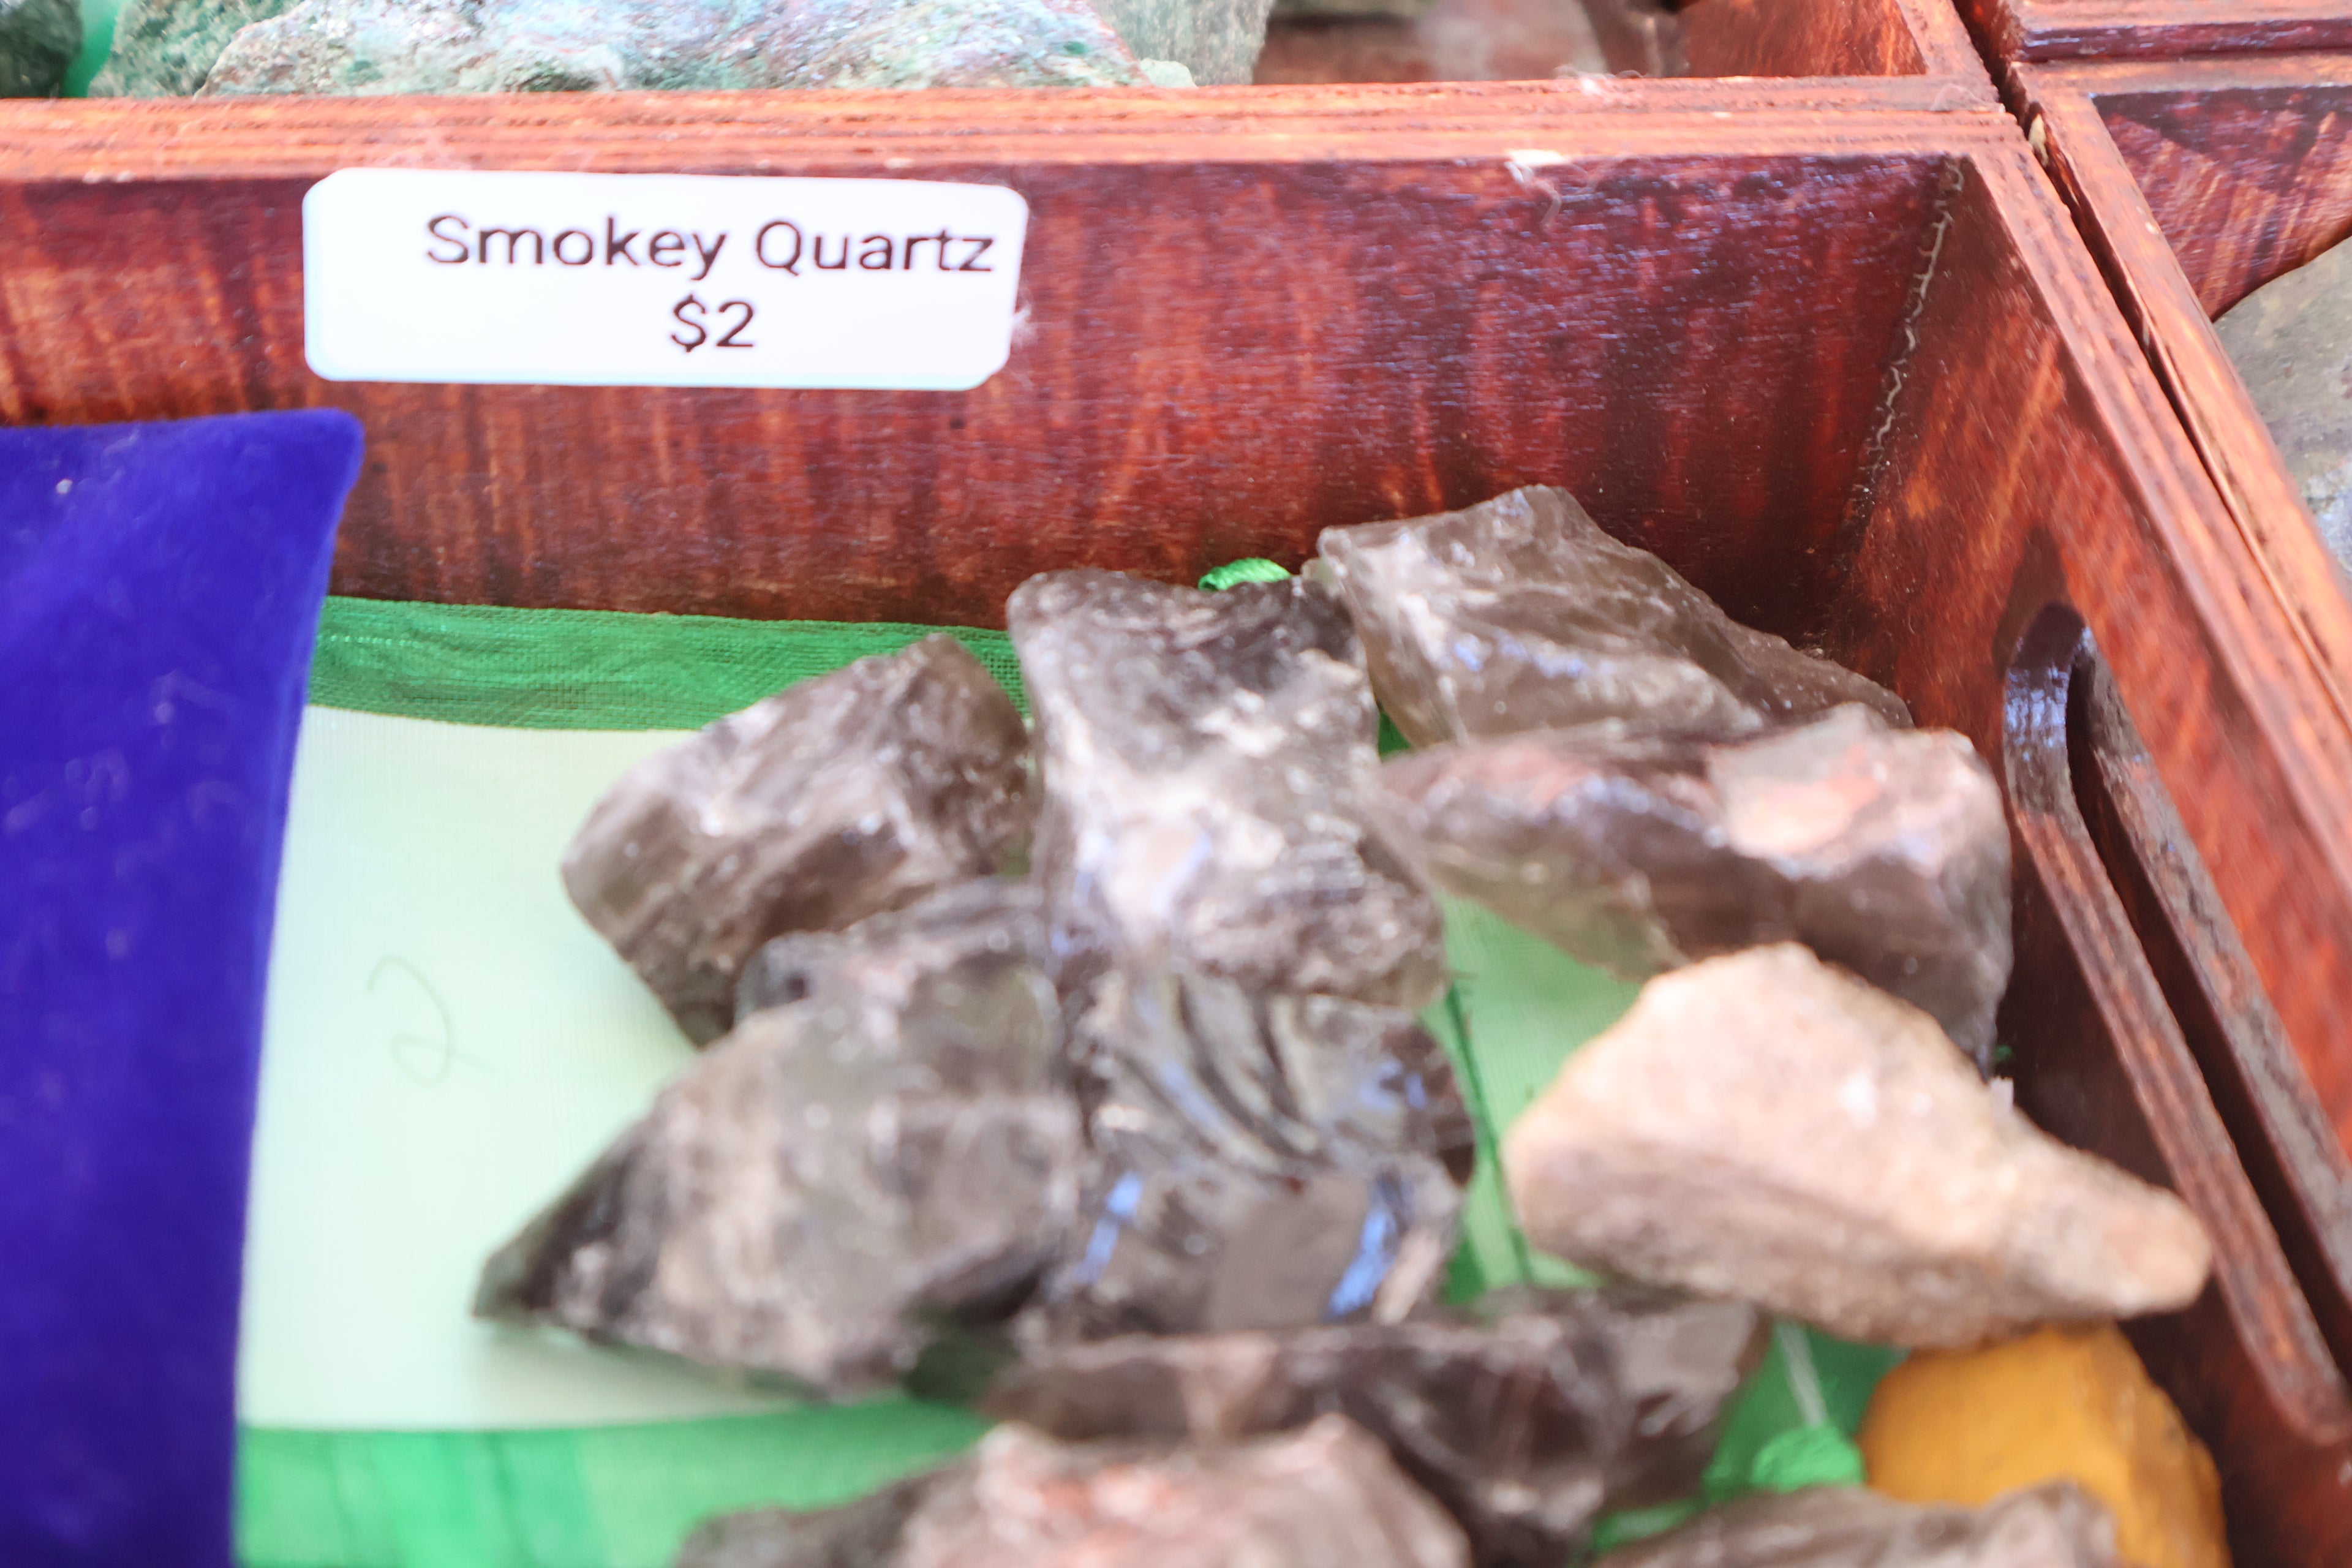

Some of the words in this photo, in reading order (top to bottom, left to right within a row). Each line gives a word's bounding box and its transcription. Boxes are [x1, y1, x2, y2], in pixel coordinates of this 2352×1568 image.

[426, 212, 728, 282] Smokey
[753, 218, 994, 277] Quartz
[669, 293, 755, 354] $2
